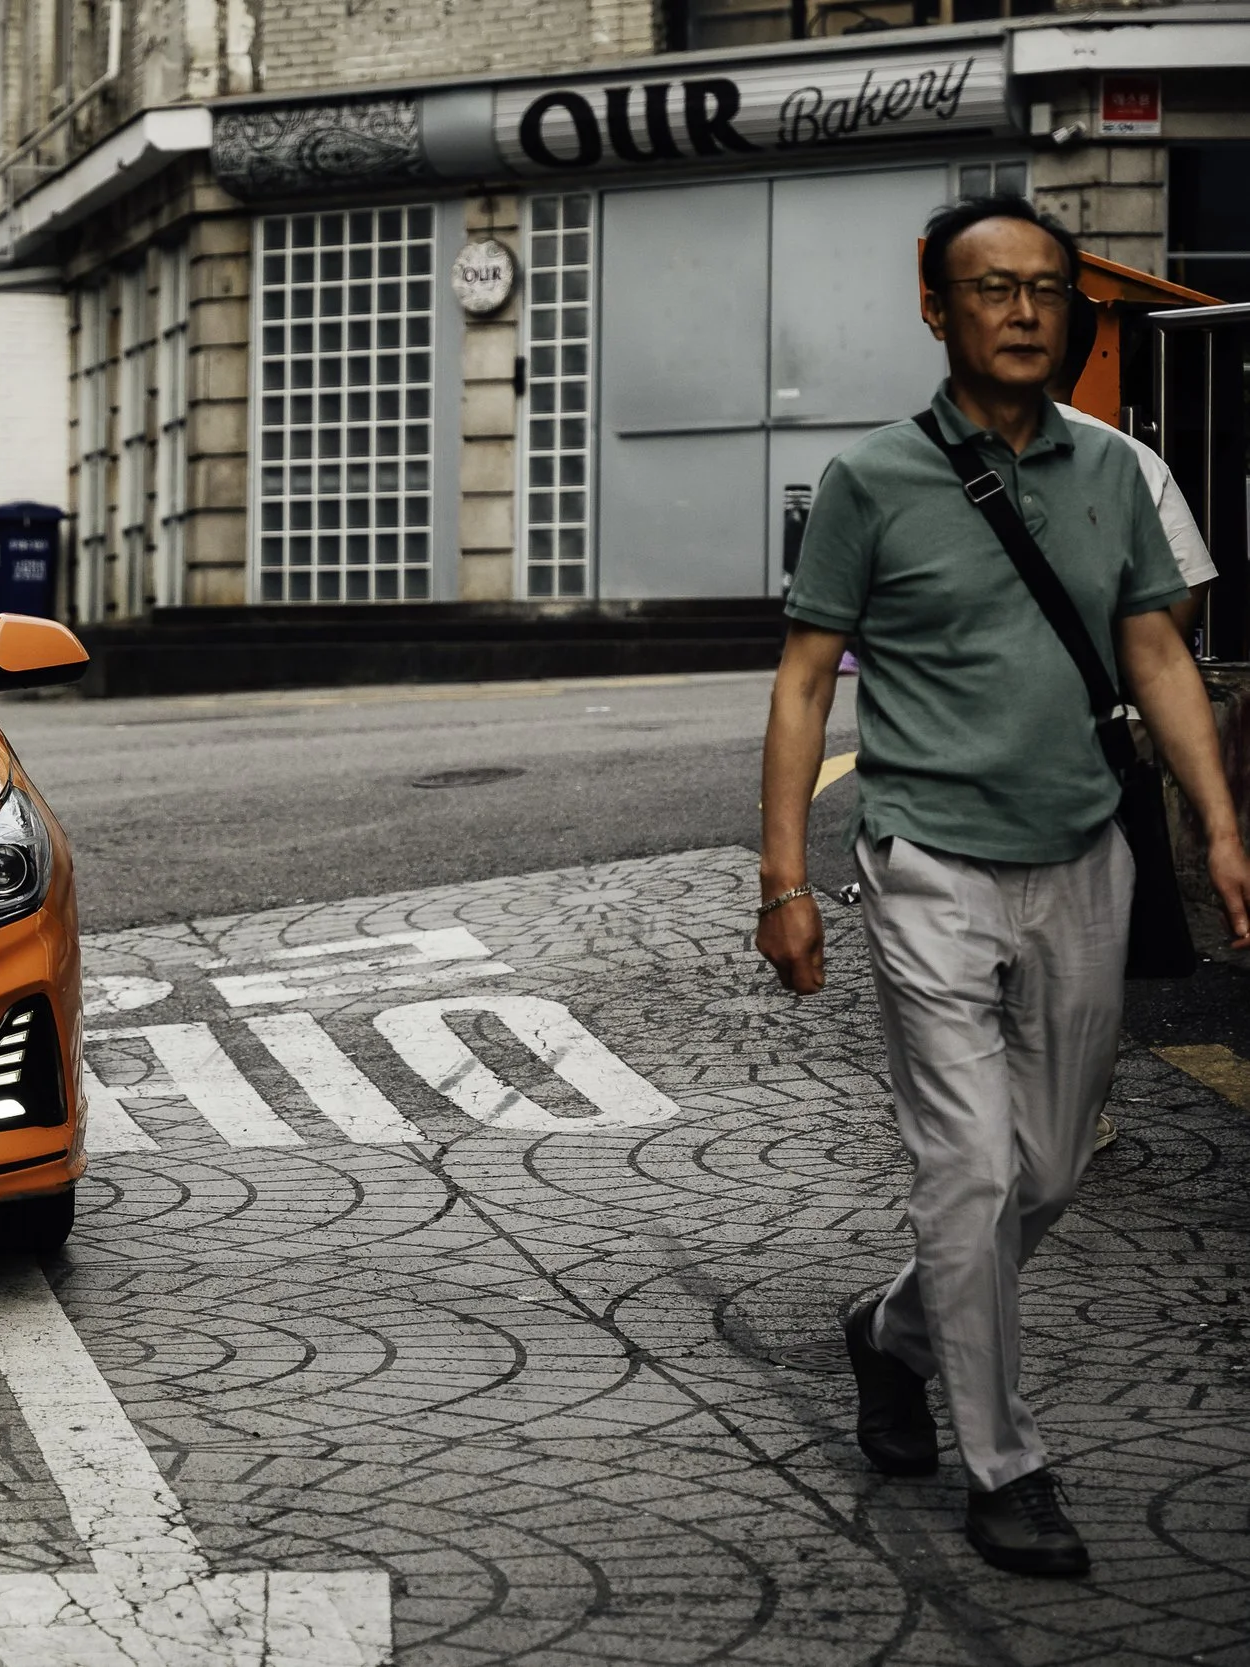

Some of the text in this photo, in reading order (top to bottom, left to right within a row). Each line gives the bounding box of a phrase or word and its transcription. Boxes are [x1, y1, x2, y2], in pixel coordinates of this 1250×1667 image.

[519, 56, 976, 167] OUR Bakery
[463, 266, 501, 283] OUR
